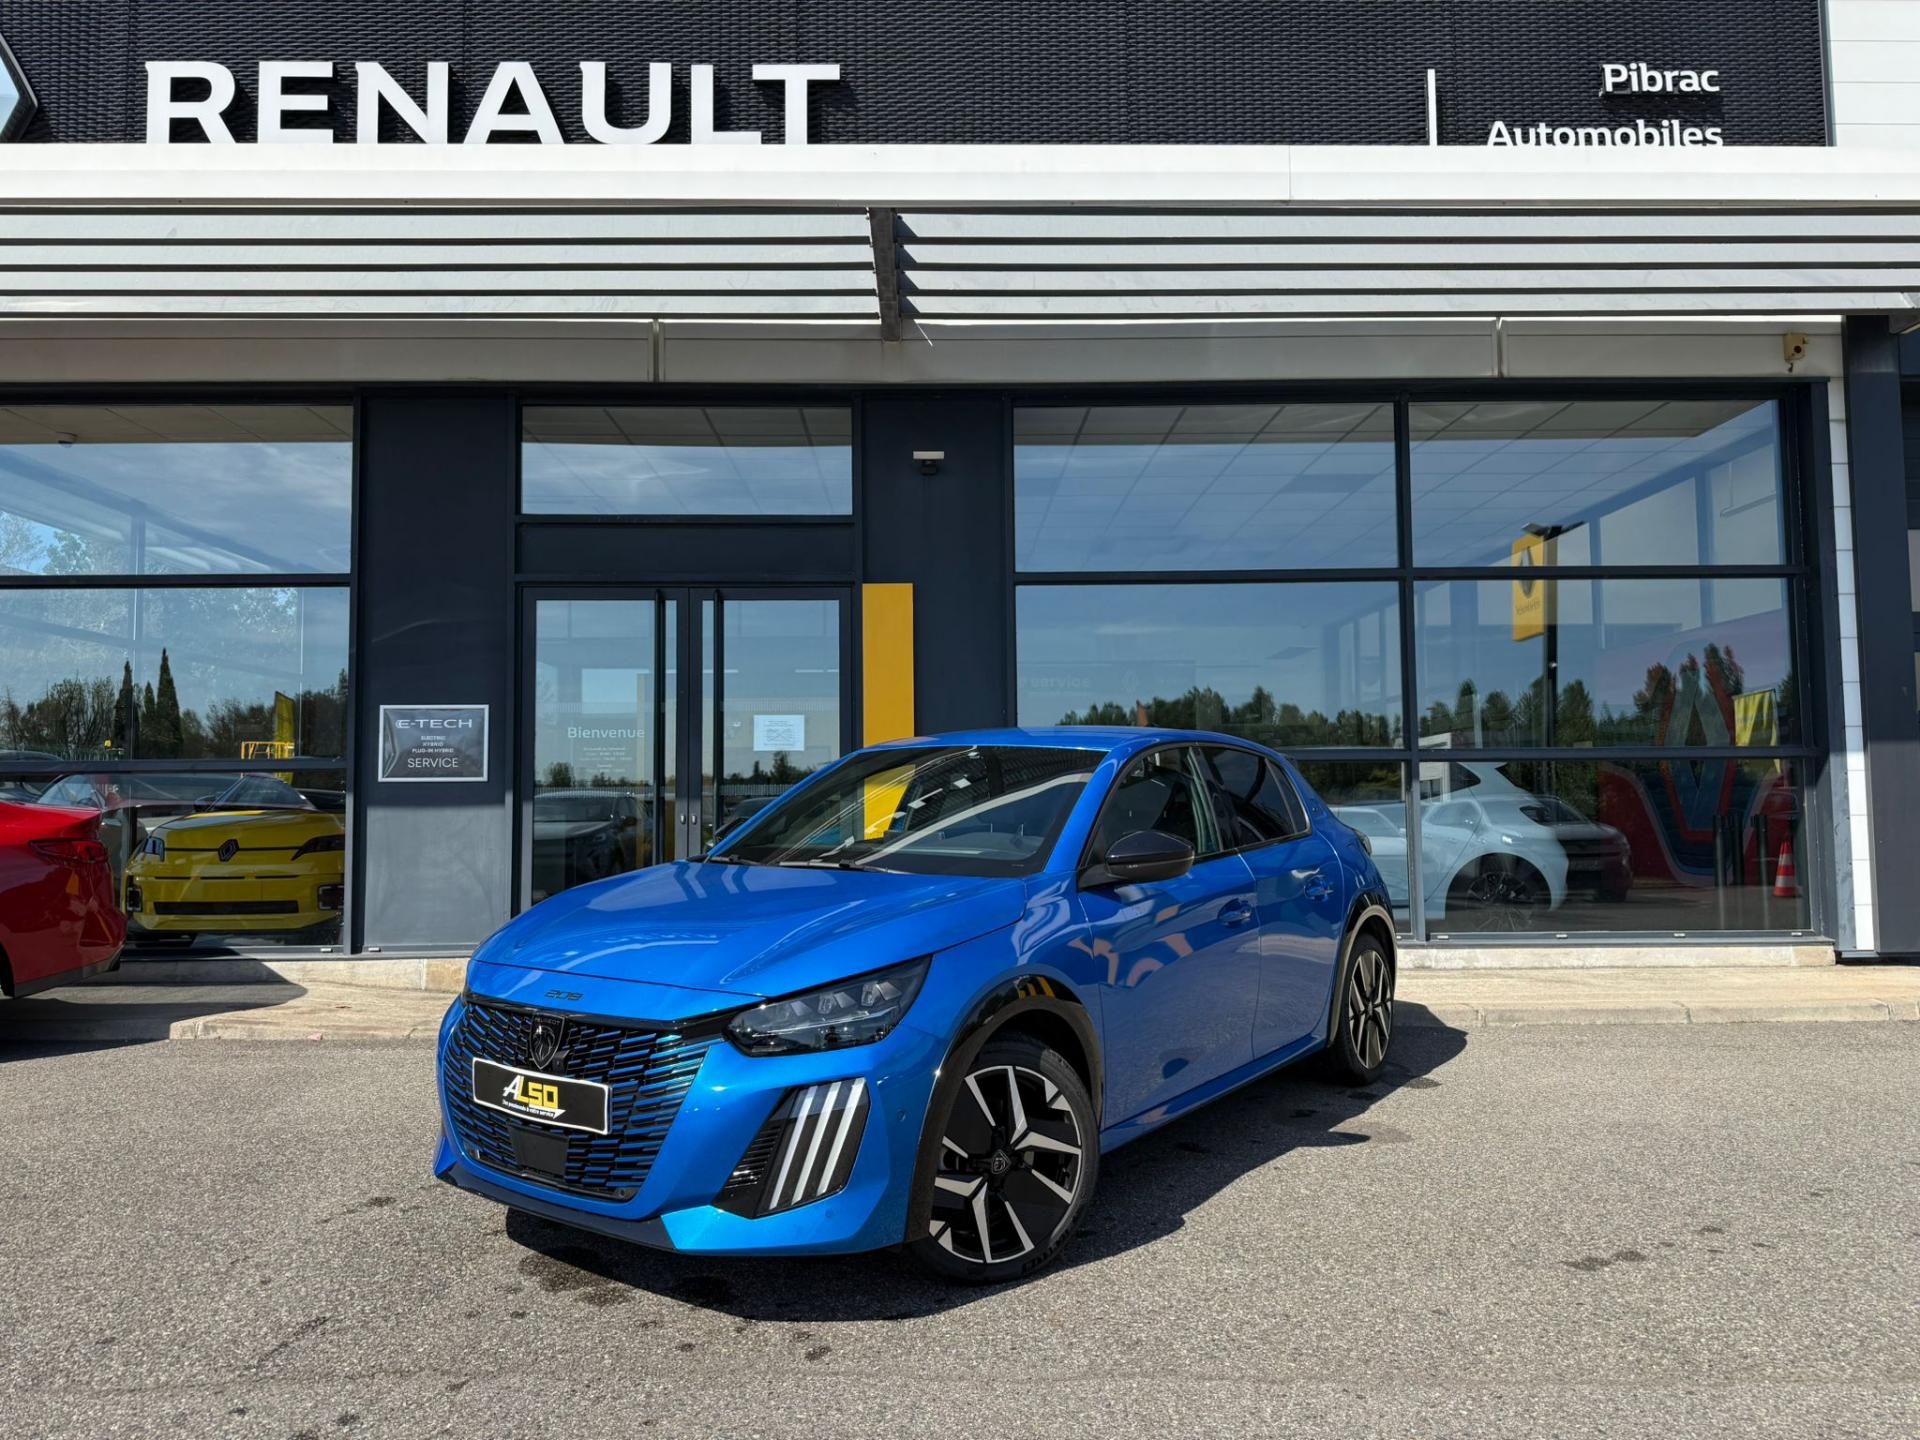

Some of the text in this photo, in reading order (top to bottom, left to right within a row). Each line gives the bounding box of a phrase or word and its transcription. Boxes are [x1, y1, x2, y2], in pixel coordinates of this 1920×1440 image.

[1602, 62, 1720, 93] Pibrac
[145, 60, 841, 145] RENAULT
[1486, 119, 1723, 147] Automobiles
[395, 719, 472, 728] E-TECH
[567, 726, 645, 738] Bienvenue
[407, 757, 459, 768] SERVICE
[544, 989, 584, 1001] 208
[502, 1074, 559, 1108] ALSO
